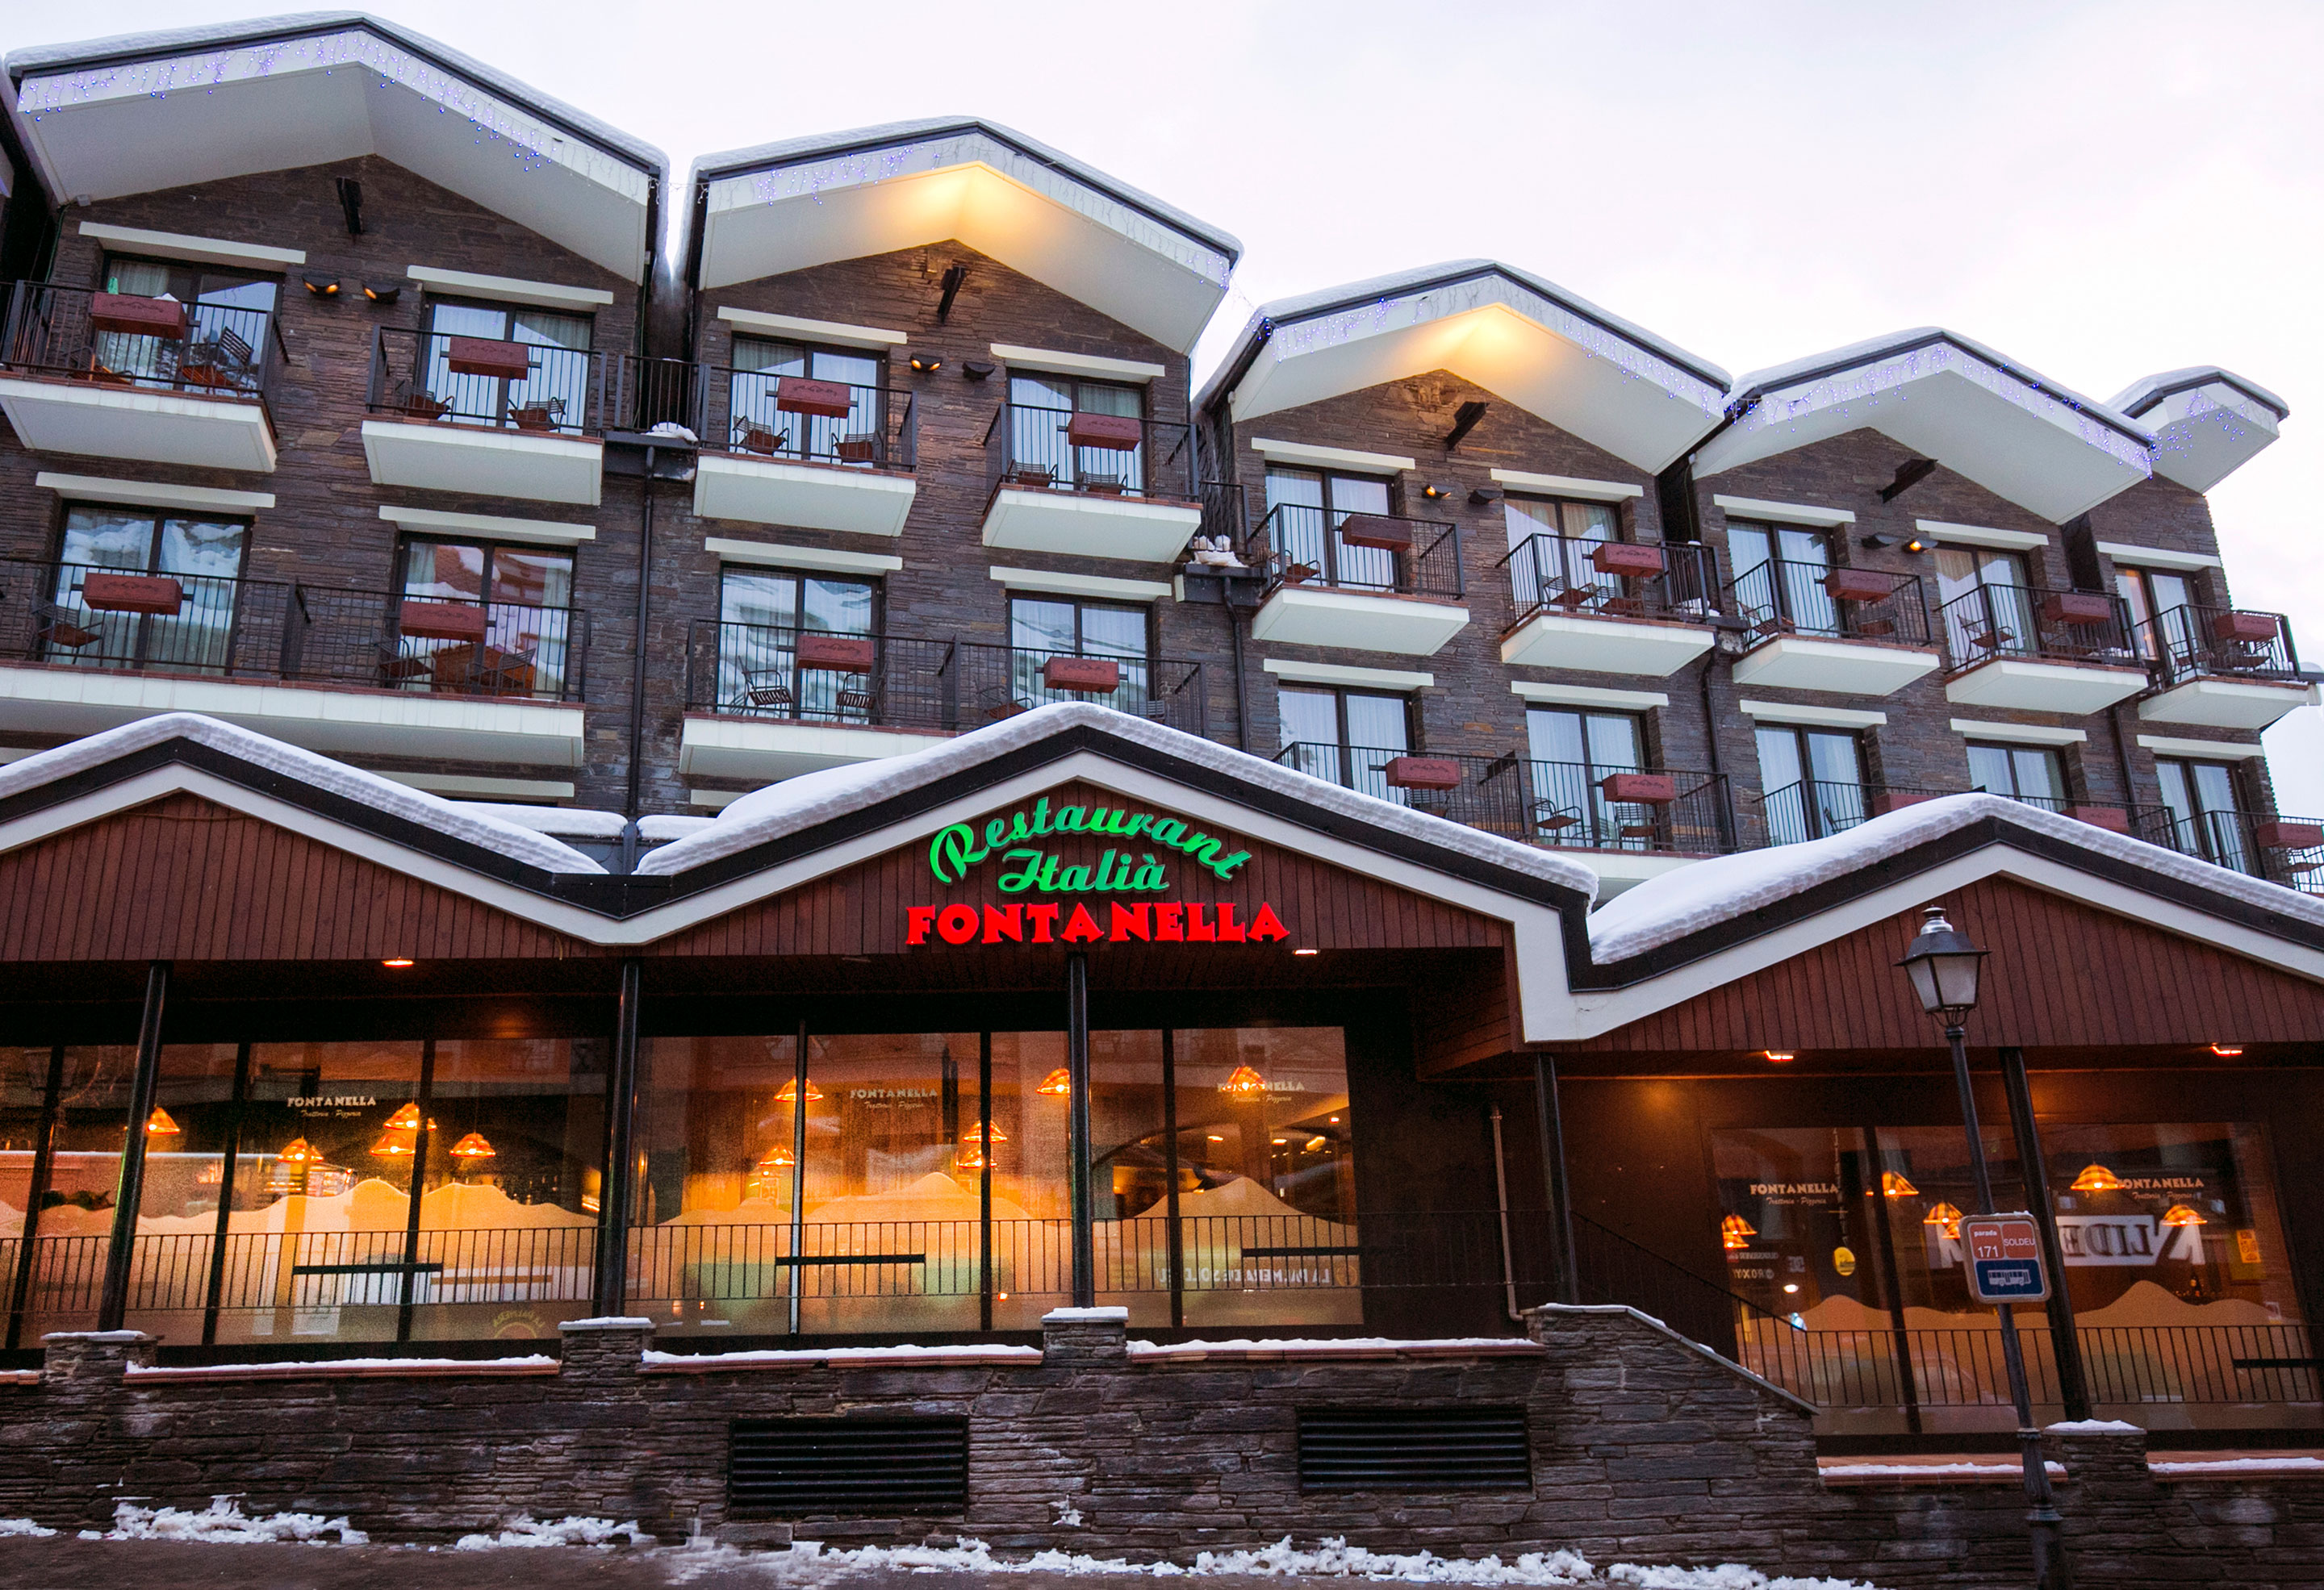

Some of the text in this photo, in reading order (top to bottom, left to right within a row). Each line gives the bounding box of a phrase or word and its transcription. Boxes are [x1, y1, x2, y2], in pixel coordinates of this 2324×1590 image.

[930, 795, 1252, 884] Restaurant
[997, 848, 1169, 893] Italià
[905, 900, 1290, 945] FONTANELLA
[850, 1088, 938, 1099] FONTANELLA
[286, 1096, 377, 1108] FONTANELLA
[1749, 1183, 1839, 1195] FONTANELLA
[1766, 1196, 1827, 1206] Trattoria Pizzeria
[1974, 1229, 1998, 1237] parada
[2003, 1237, 2035, 1246] SOLDEU
[1977, 1245, 1999, 1258] 171
